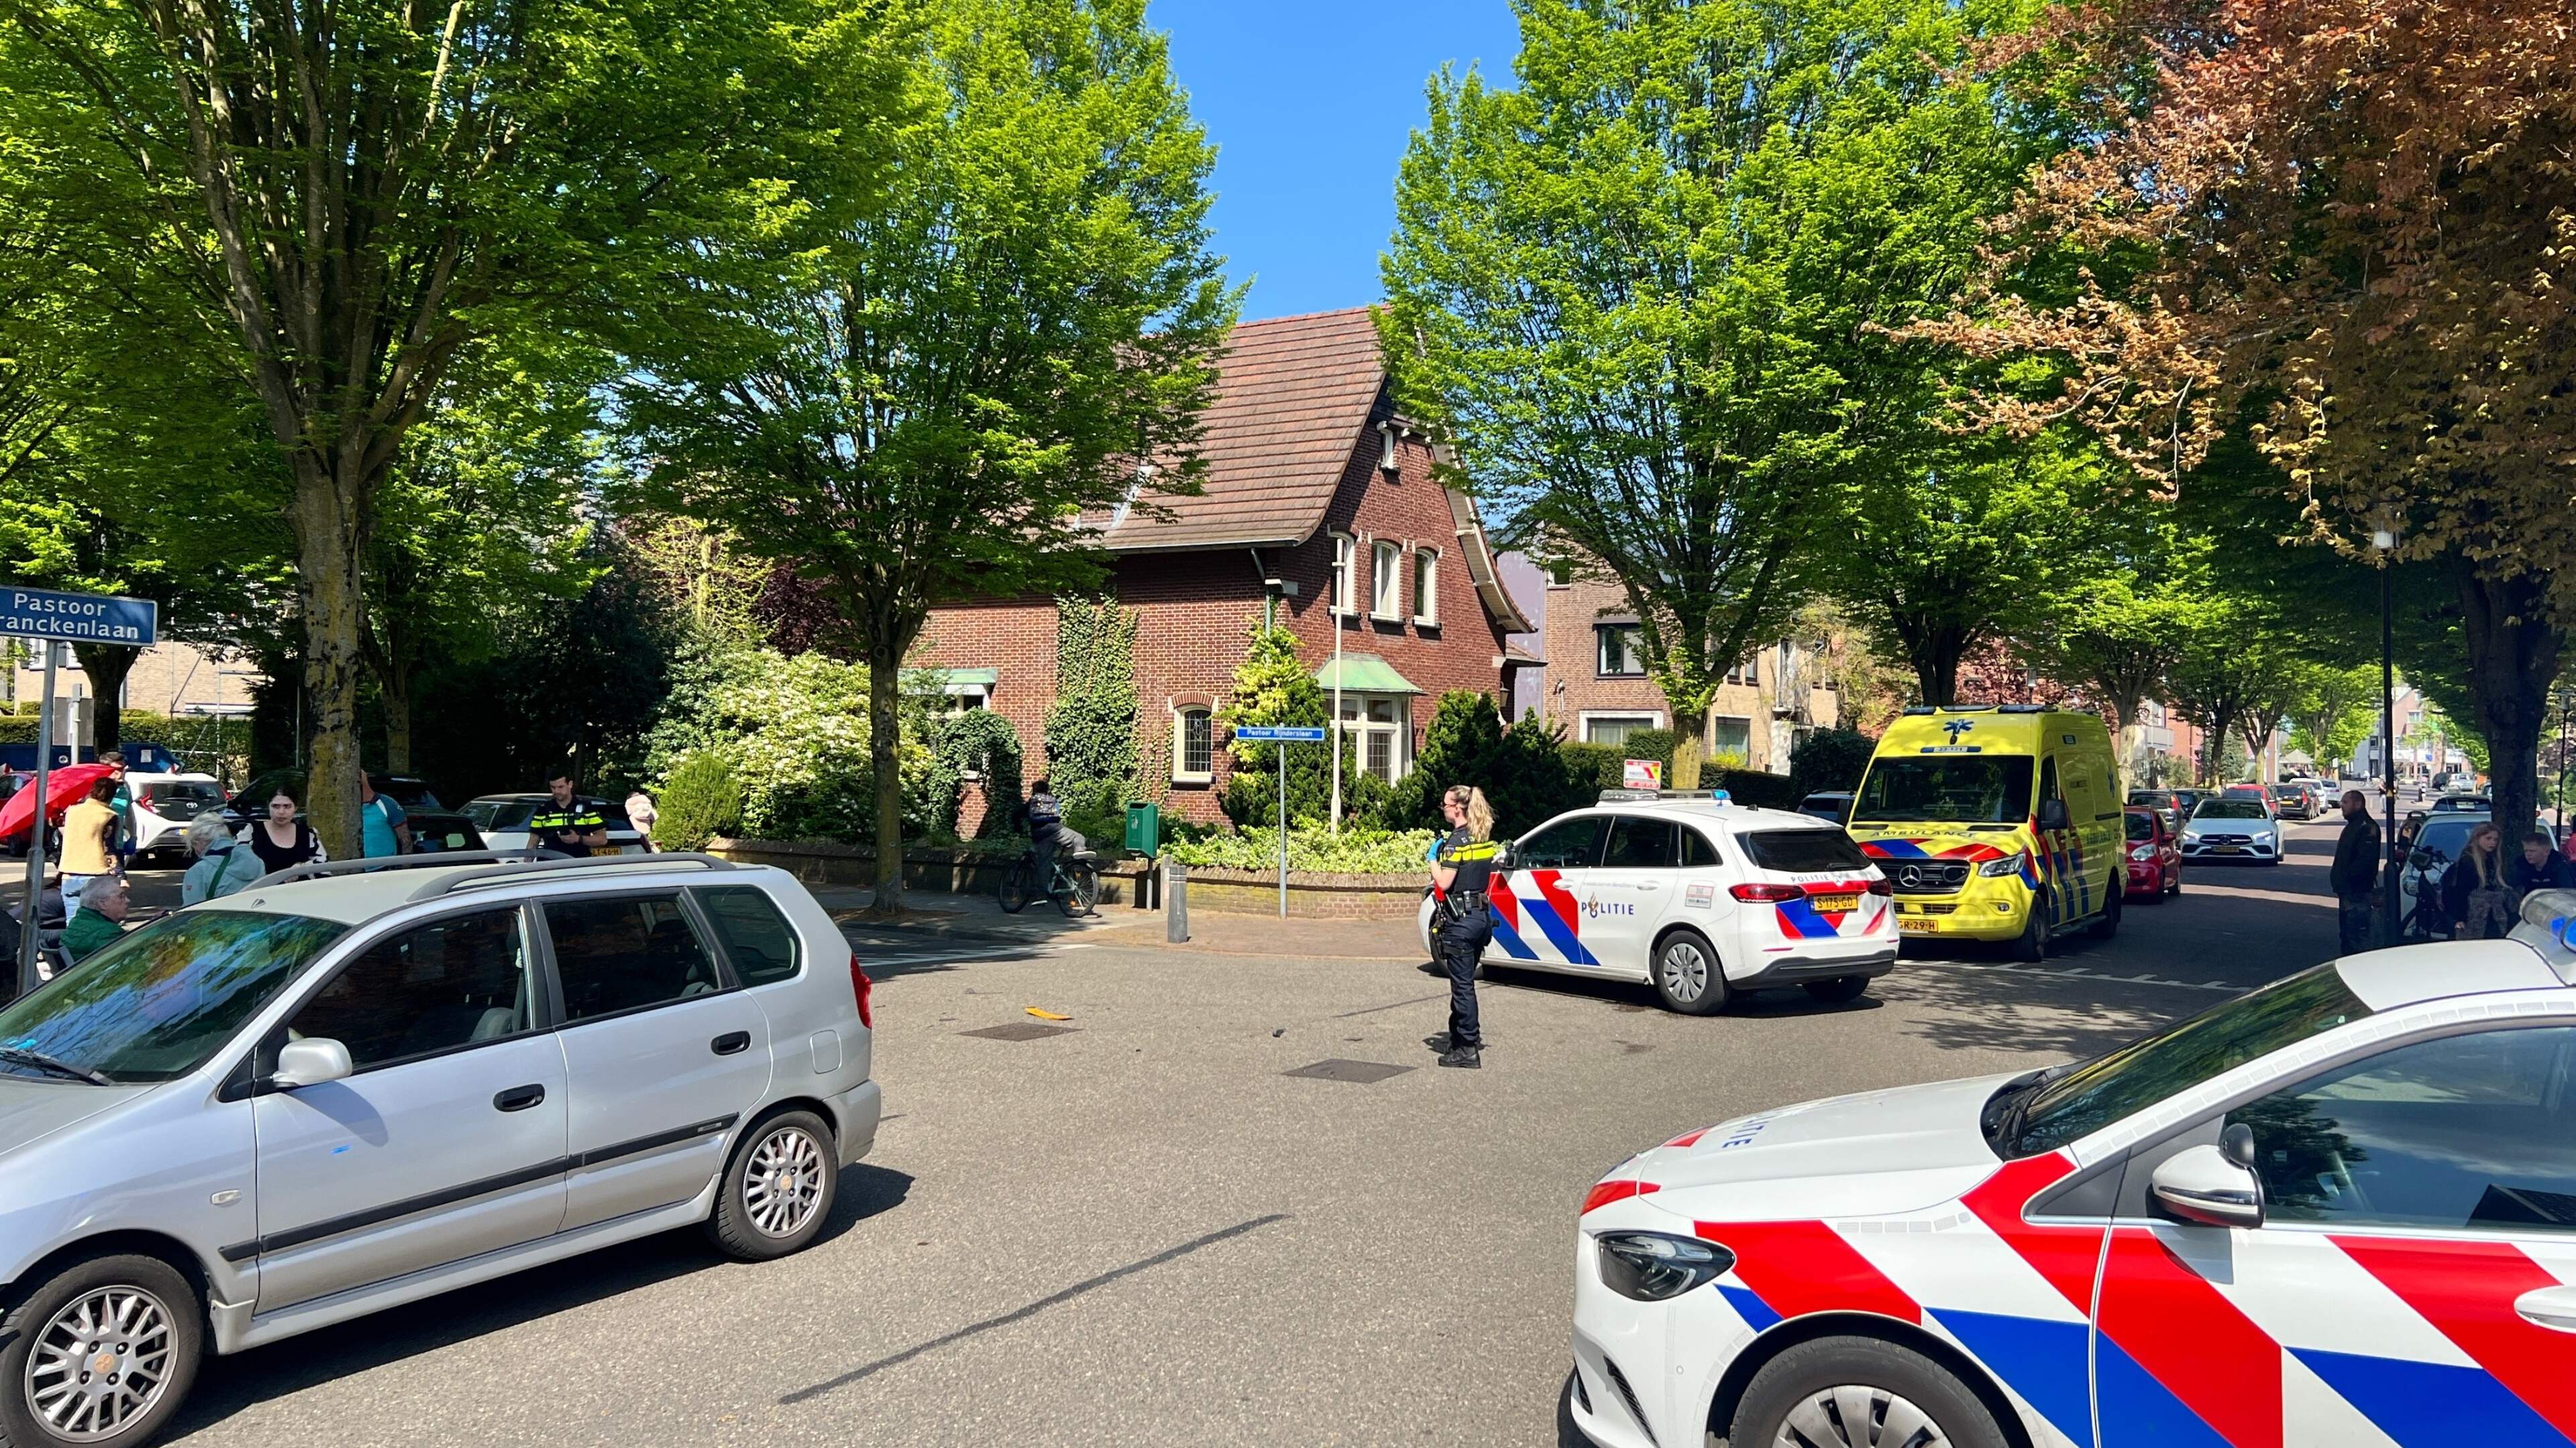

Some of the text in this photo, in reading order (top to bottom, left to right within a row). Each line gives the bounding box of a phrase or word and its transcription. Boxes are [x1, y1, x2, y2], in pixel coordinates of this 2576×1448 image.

[13, 593, 106, 616] Pastoor
[1247, 728, 1272, 736] Pastoor
[1870, 830, 1976, 838] AMBULANCE
[1790, 874, 1829, 883] POLITIE
[1817, 897, 1853, 909] S-175-GD
[1581, 901, 1634, 918] POLITIE
[1721, 1115, 1776, 1149] LITIE
